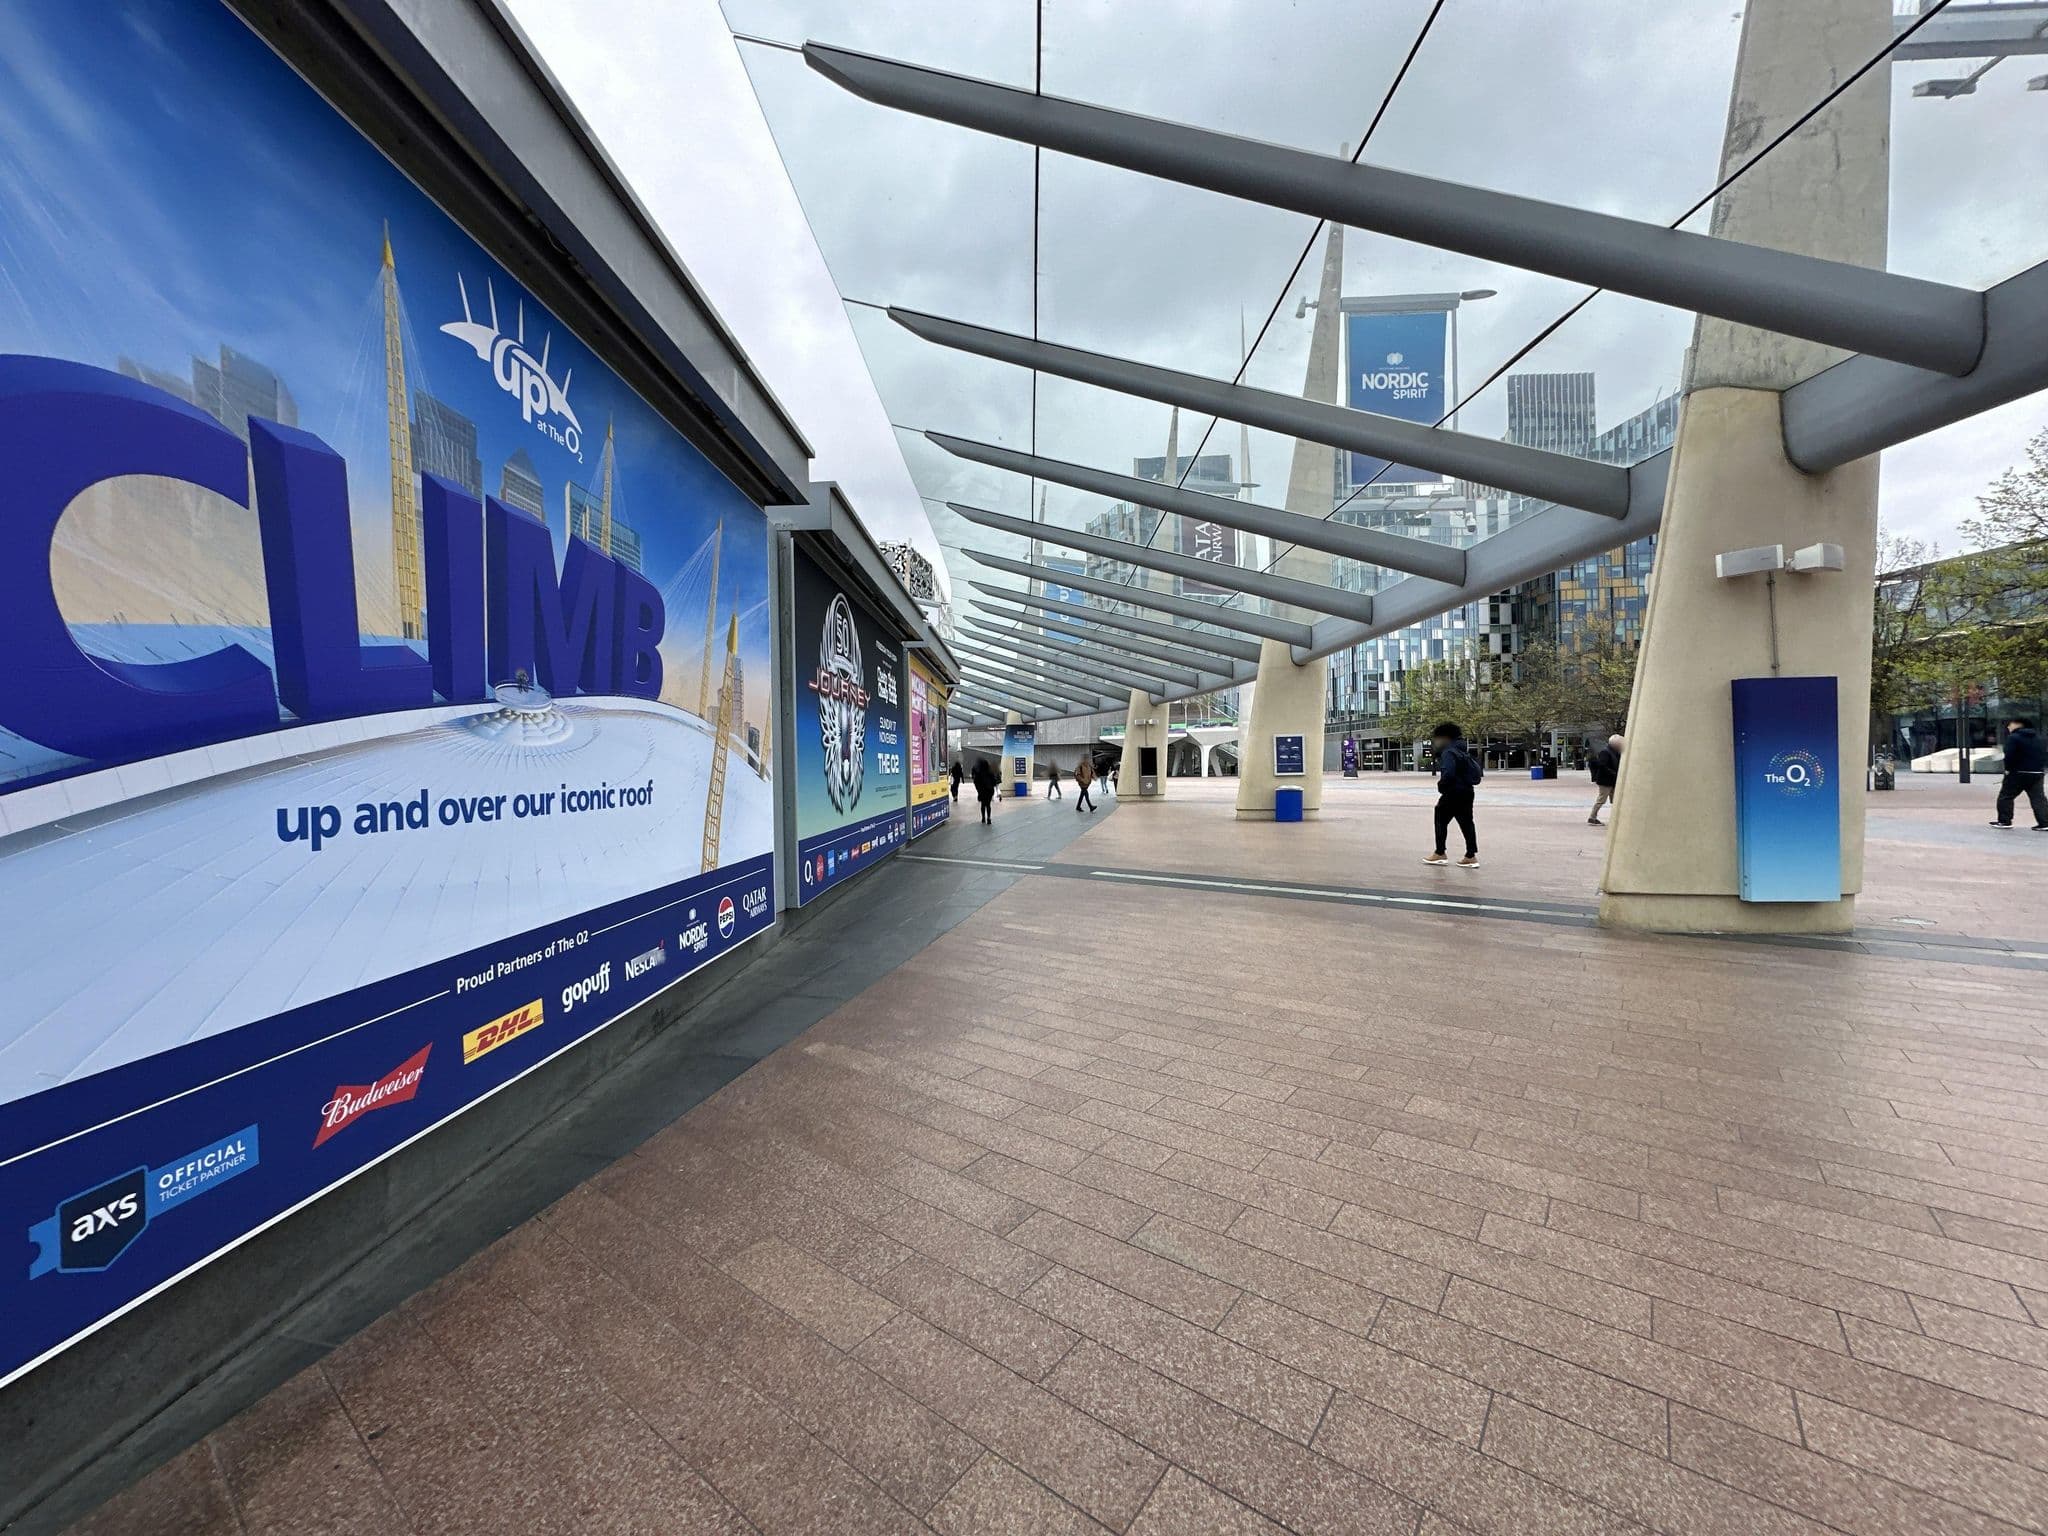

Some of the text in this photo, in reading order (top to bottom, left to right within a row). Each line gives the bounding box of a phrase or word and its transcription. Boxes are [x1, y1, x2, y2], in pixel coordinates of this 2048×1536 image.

[493, 338, 548, 423] up
[1361, 371, 1429, 390] NORDIC
[1392, 388, 1429, 400] SPIRIT
[536, 419, 583, 464] at The O2
[0, 354, 665, 765] CLIMB
[1194, 521, 1211, 560] ATA
[808, 666, 871, 709] JOURNEY
[877, 752, 900, 774] THE O2
[1764, 764, 1811, 787] The O2
[276, 779, 654, 852] up and over our iconic roof
[719, 911, 734, 924] PEPSI
[742, 886, 767, 912] QATAR
[679, 922, 708, 950] NORDIC
[693, 938, 708, 953] SPIRIT
[456, 930, 589, 995] Proud Partners of The O2
[625, 945, 666, 981] NESCA
[562, 961, 611, 1013] gopuff
[475, 1008, 535, 1053] DHL
[321, 1066, 425, 1128] Budweiser
[158, 1139, 246, 1190] OFFICIAL
[159, 1152, 247, 1203] TICKET PARTNER
[70, 1191, 138, 1243] axs
